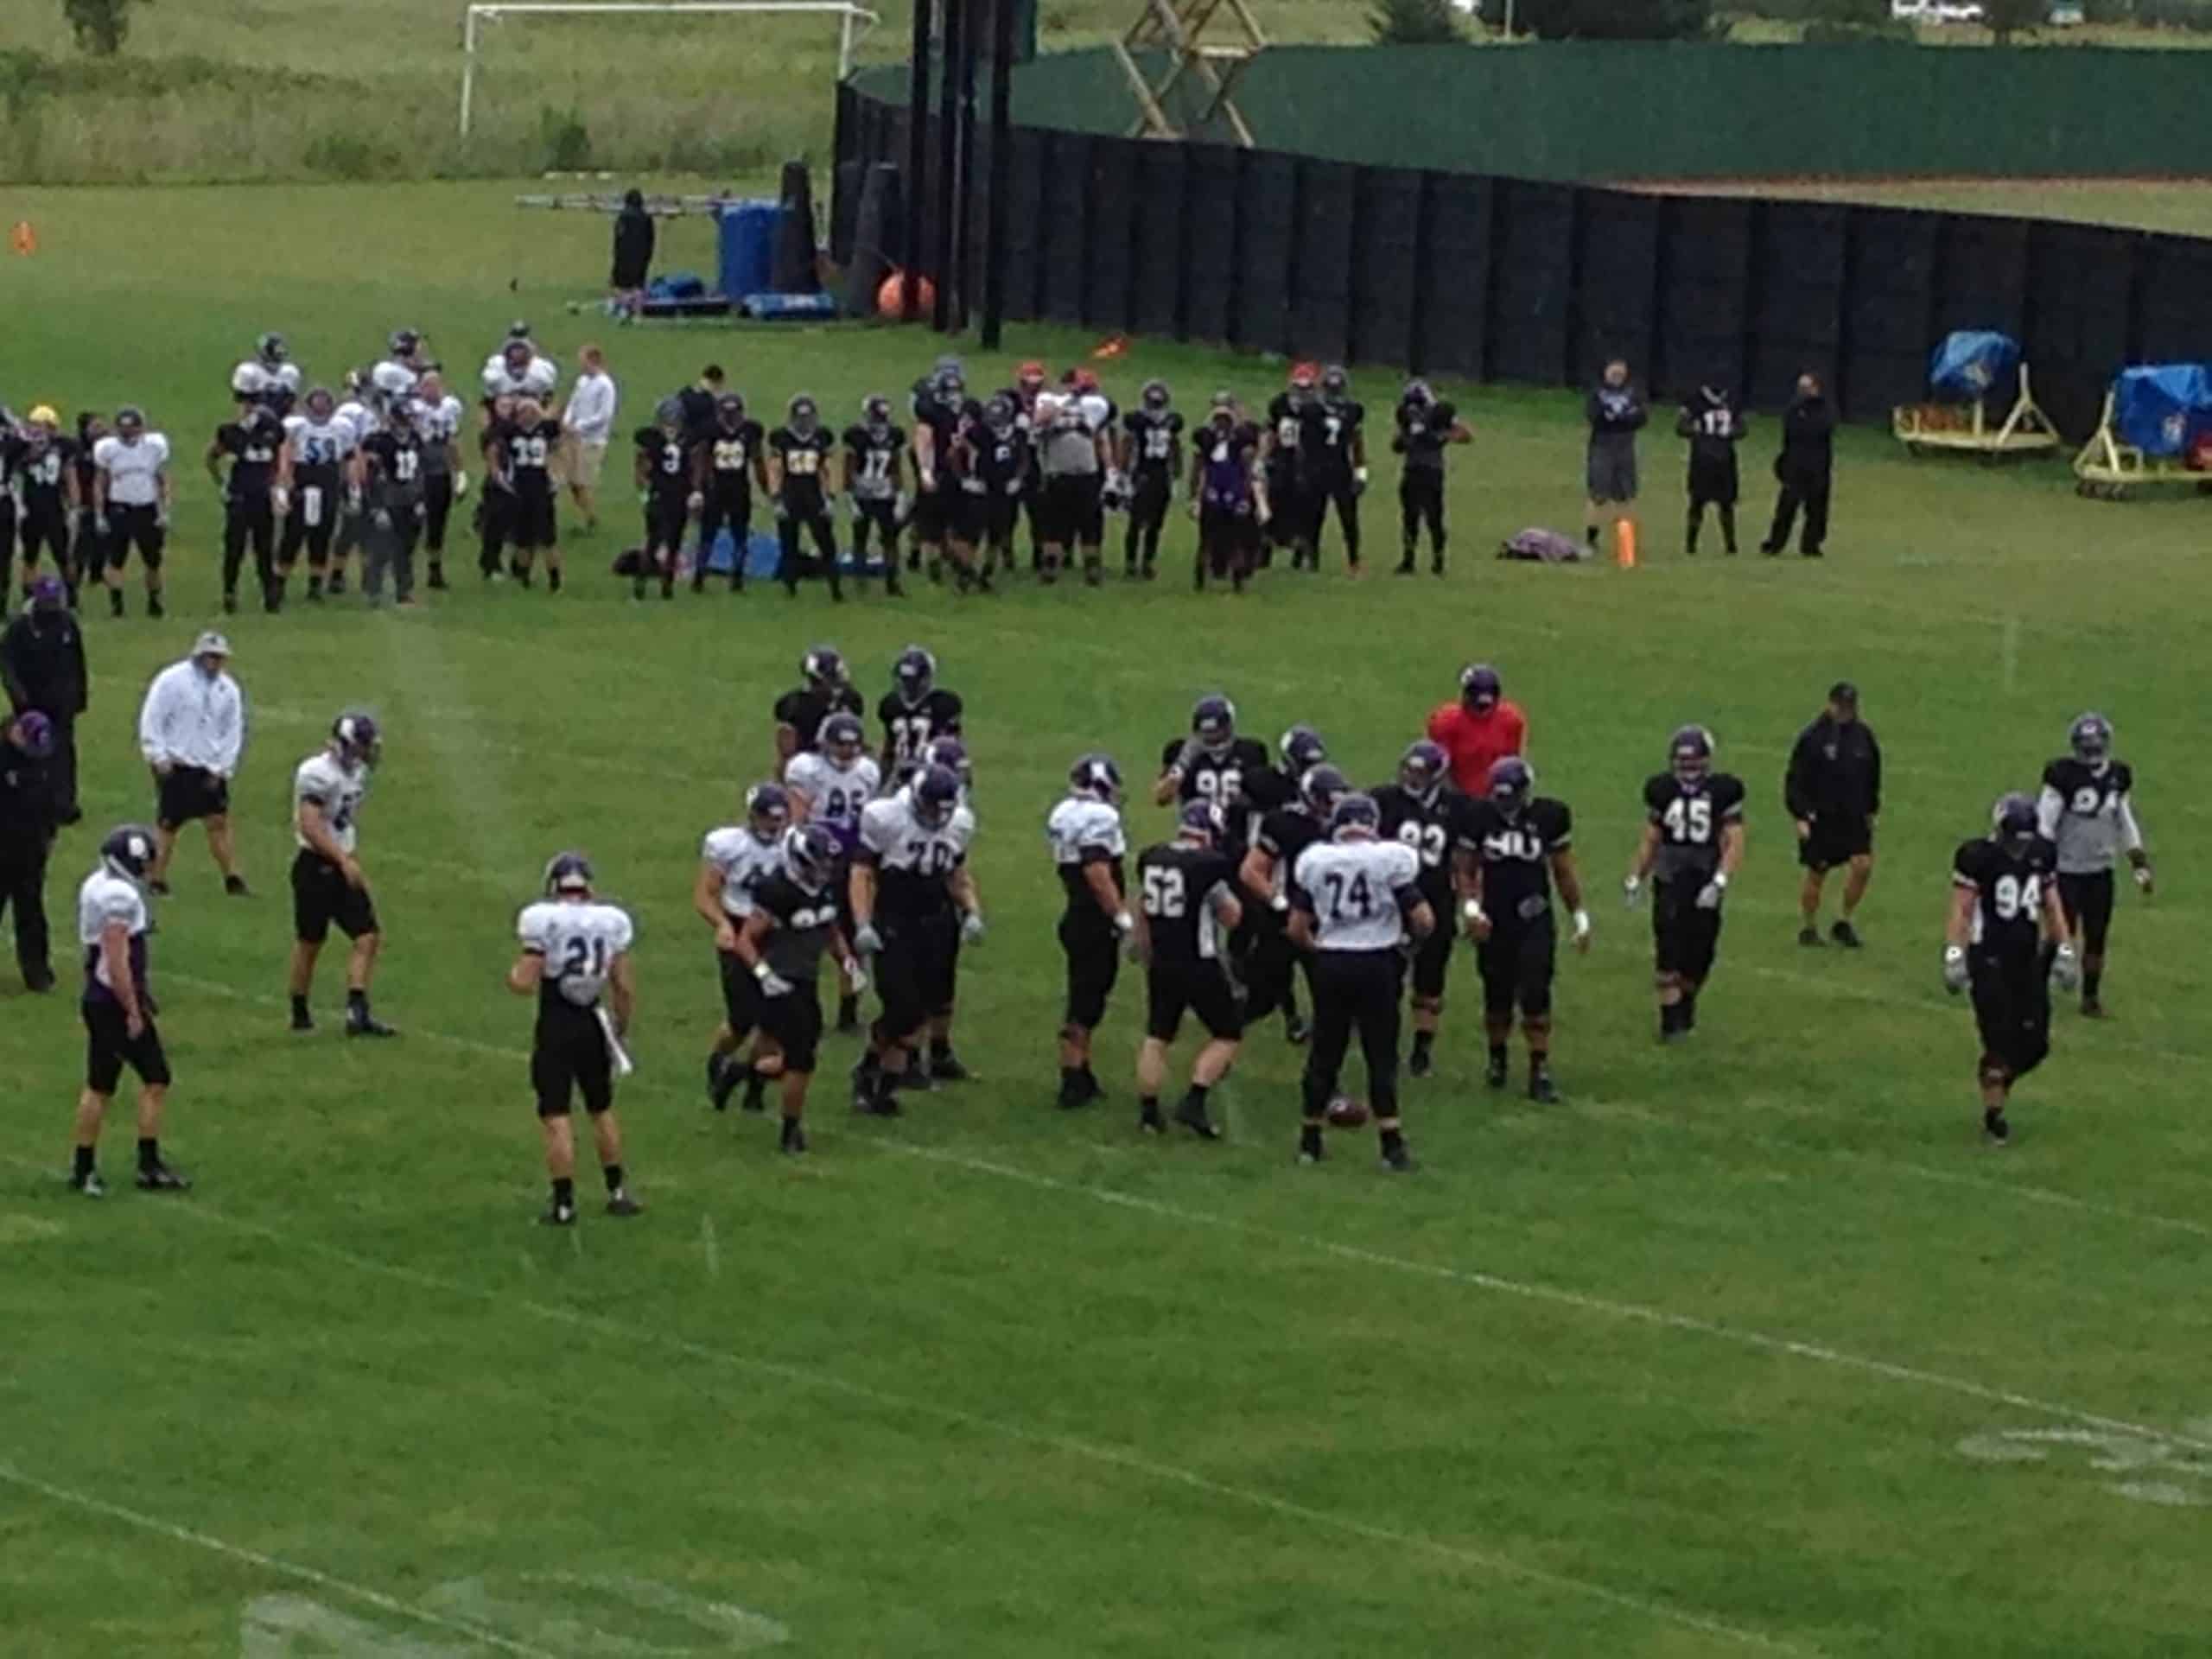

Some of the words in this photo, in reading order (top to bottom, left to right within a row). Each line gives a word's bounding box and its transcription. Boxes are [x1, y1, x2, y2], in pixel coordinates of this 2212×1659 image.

[663, 442, 681, 474] 3
[1664, 798, 1711, 842] 45
[1143, 865, 1185, 918] 52
[1324, 873, 1370, 920] 74
[1994, 873, 2041, 921] 94
[564, 936, 605, 976] 21
